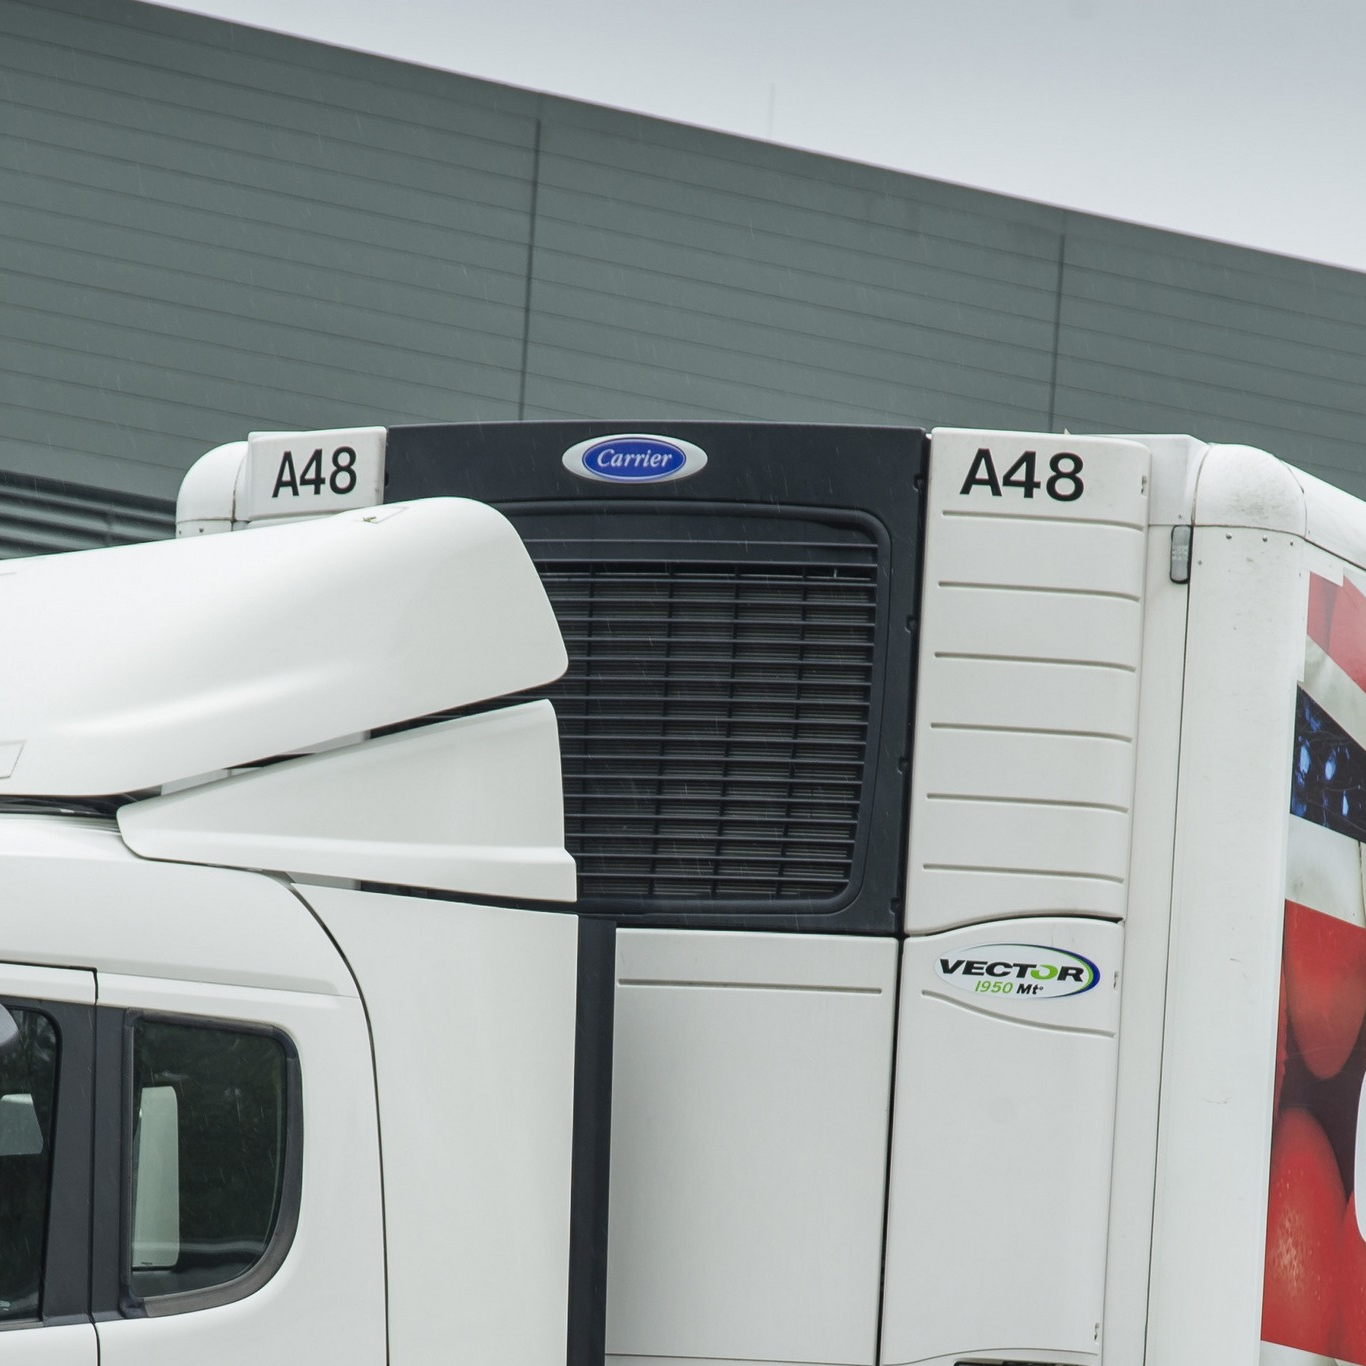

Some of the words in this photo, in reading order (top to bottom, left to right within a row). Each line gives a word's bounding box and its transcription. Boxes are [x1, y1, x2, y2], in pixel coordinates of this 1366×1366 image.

[597, 449, 672, 467] Carrier
[272, 446, 357, 498] A48
[960, 448, 1084, 502] A48
[940, 959, 1084, 982] VECTOR
[975, 980, 1013, 994] 1950
